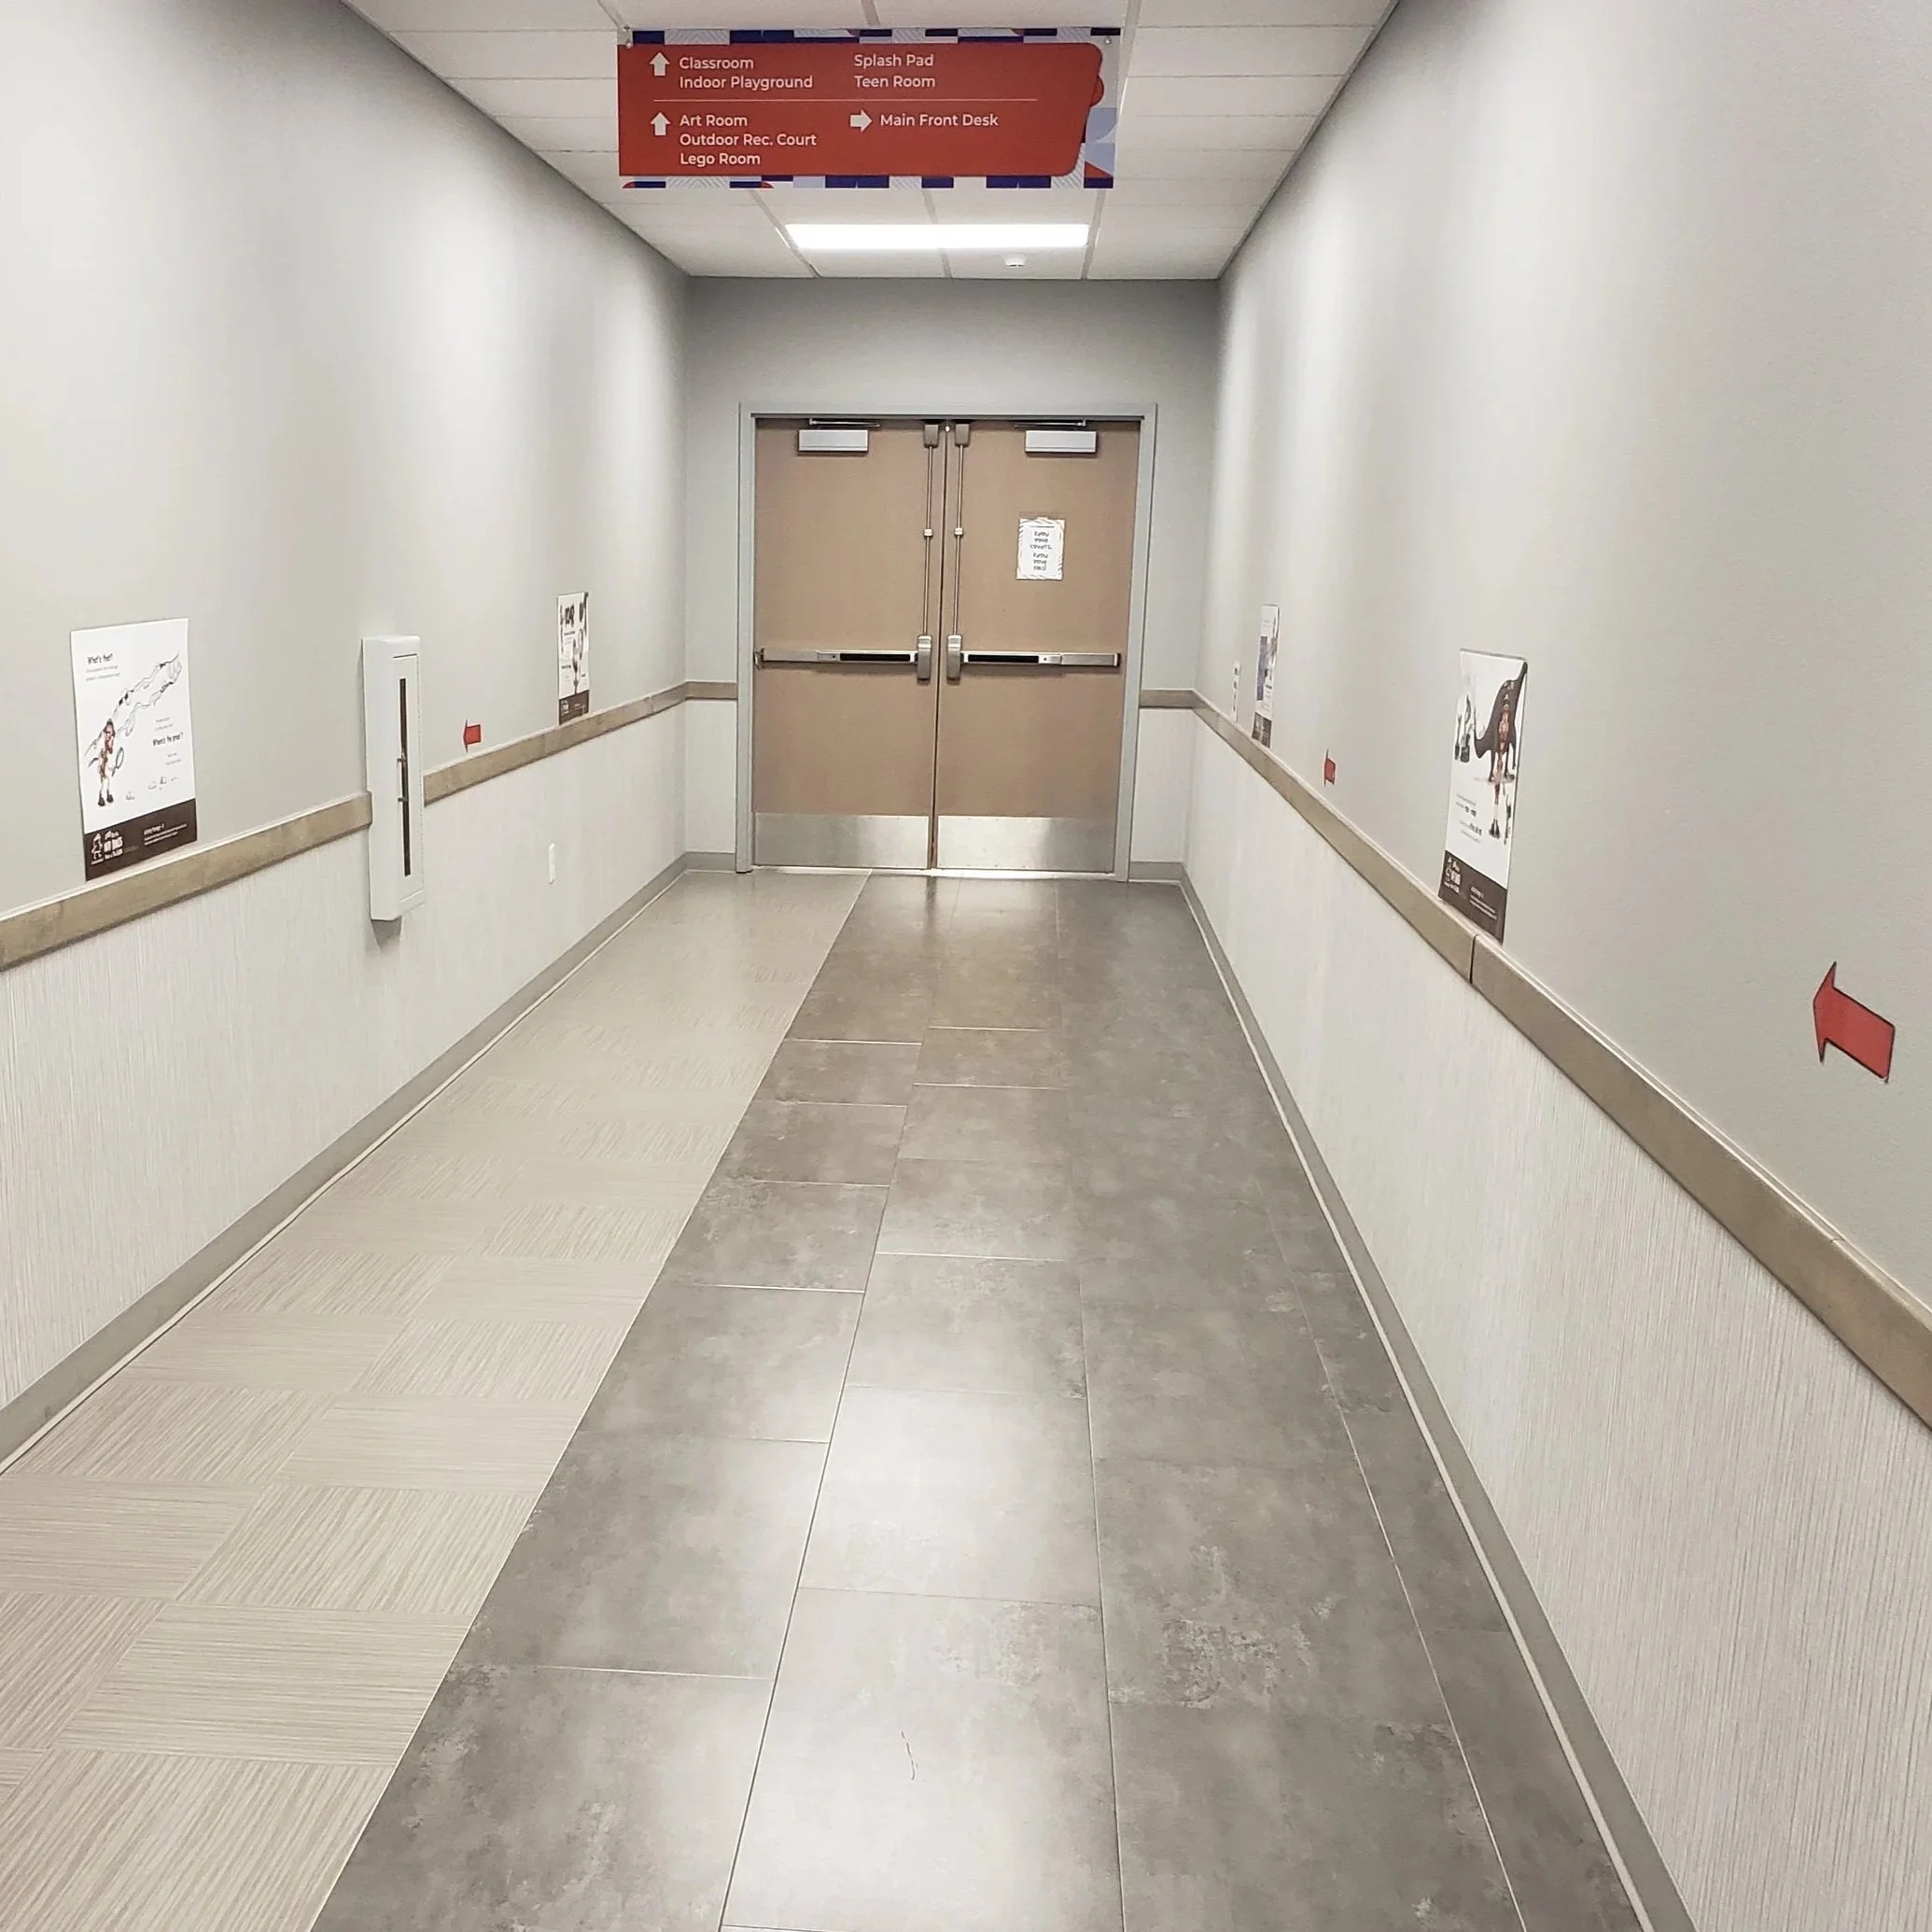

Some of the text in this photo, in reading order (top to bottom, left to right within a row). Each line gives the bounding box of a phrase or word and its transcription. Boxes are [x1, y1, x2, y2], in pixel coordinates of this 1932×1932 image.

[679, 56, 754, 70] Classroom
[854, 53, 934, 70] Splash Pad
[679, 75, 813, 91] Indoor Playground
[854, 75, 936, 88] Teen Room
[679, 114, 748, 127] Art Room
[880, 113, 999, 127] Main Front Desk
[679, 133, 818, 146] Outdoor Rec. Court
[680, 152, 761, 168] Lego Room
